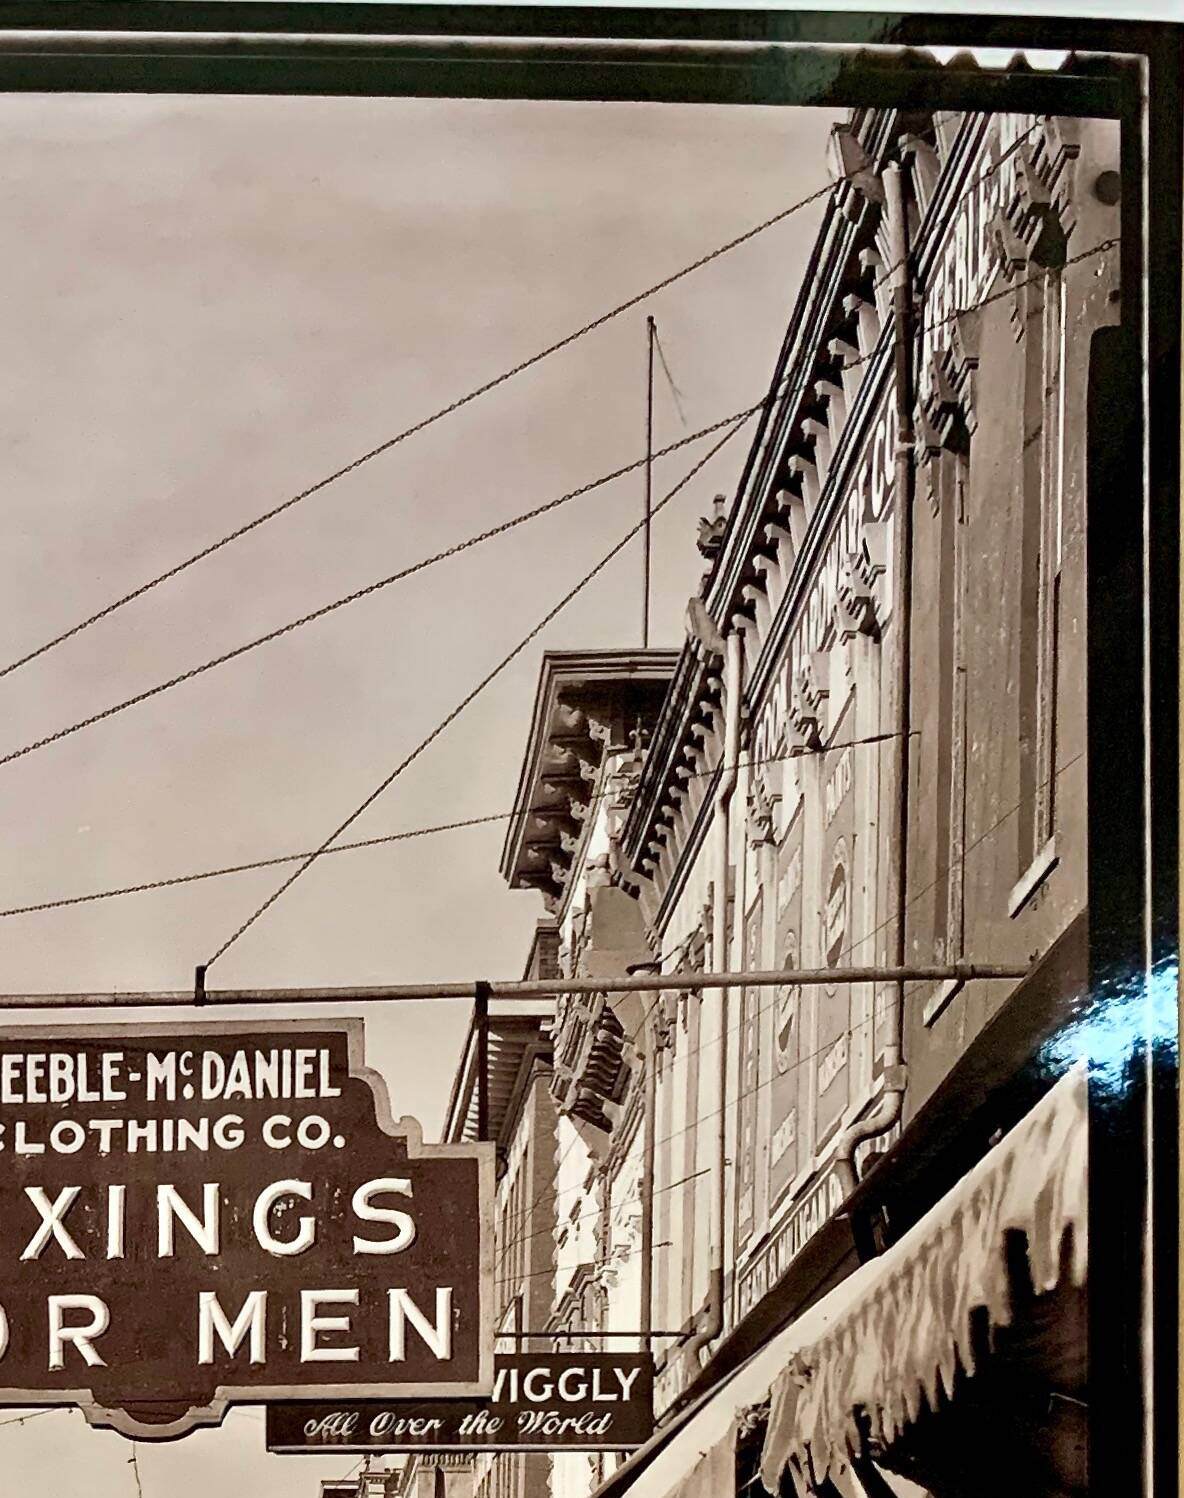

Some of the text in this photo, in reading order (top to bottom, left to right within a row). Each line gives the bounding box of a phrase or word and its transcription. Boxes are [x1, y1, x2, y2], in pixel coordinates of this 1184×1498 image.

[262, 1114, 346, 1151] CO.
[198, 1286, 454, 1366] MEN
[303, 1409, 614, 1438] All Over the World
